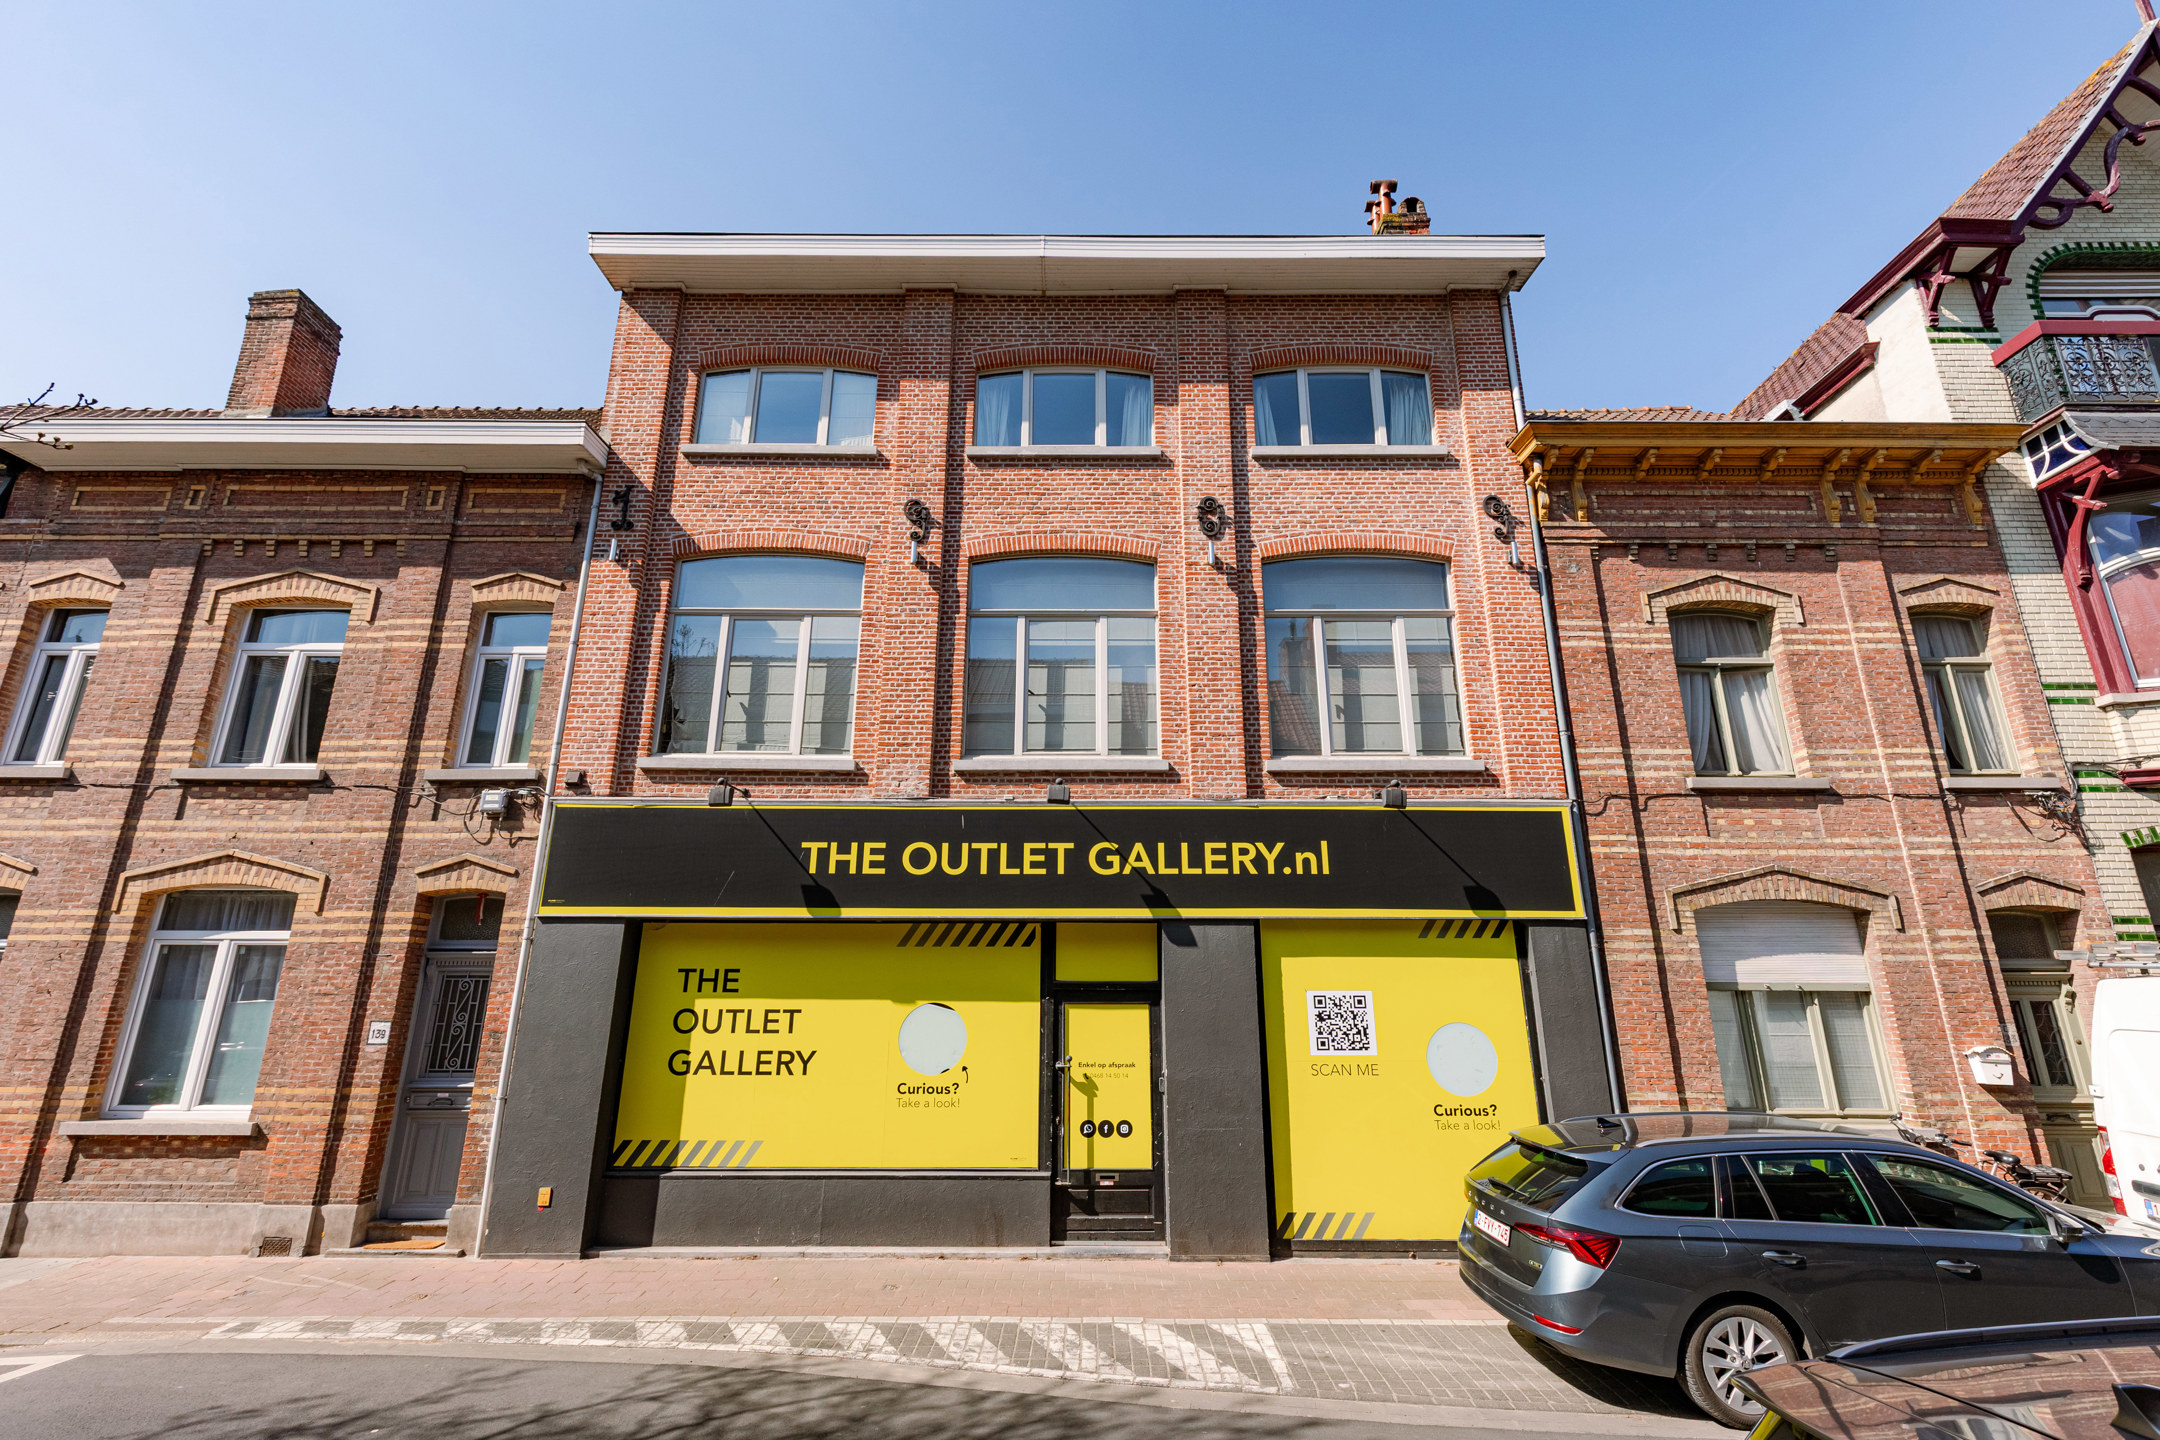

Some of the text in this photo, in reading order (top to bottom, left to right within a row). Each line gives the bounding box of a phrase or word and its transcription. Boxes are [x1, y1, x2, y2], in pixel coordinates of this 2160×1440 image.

[801, 839, 1330, 877] THE OUTLET GALLERY.nl
[677, 968, 741, 993] THE
[672, 1008, 803, 1035] OUTLET
[371, 1029, 387, 1039] 139
[667, 1049, 818, 1077] GALLERY
[1108, 1061, 1136, 1069] afspraak
[1310, 1063, 1380, 1077] SCAN ME
[897, 1082, 960, 1095] Curious?
[896, 1097, 961, 1108] Take a look!
[1433, 1104, 1498, 1117] Curious?
[1434, 1119, 1501, 1131] Take a look!
